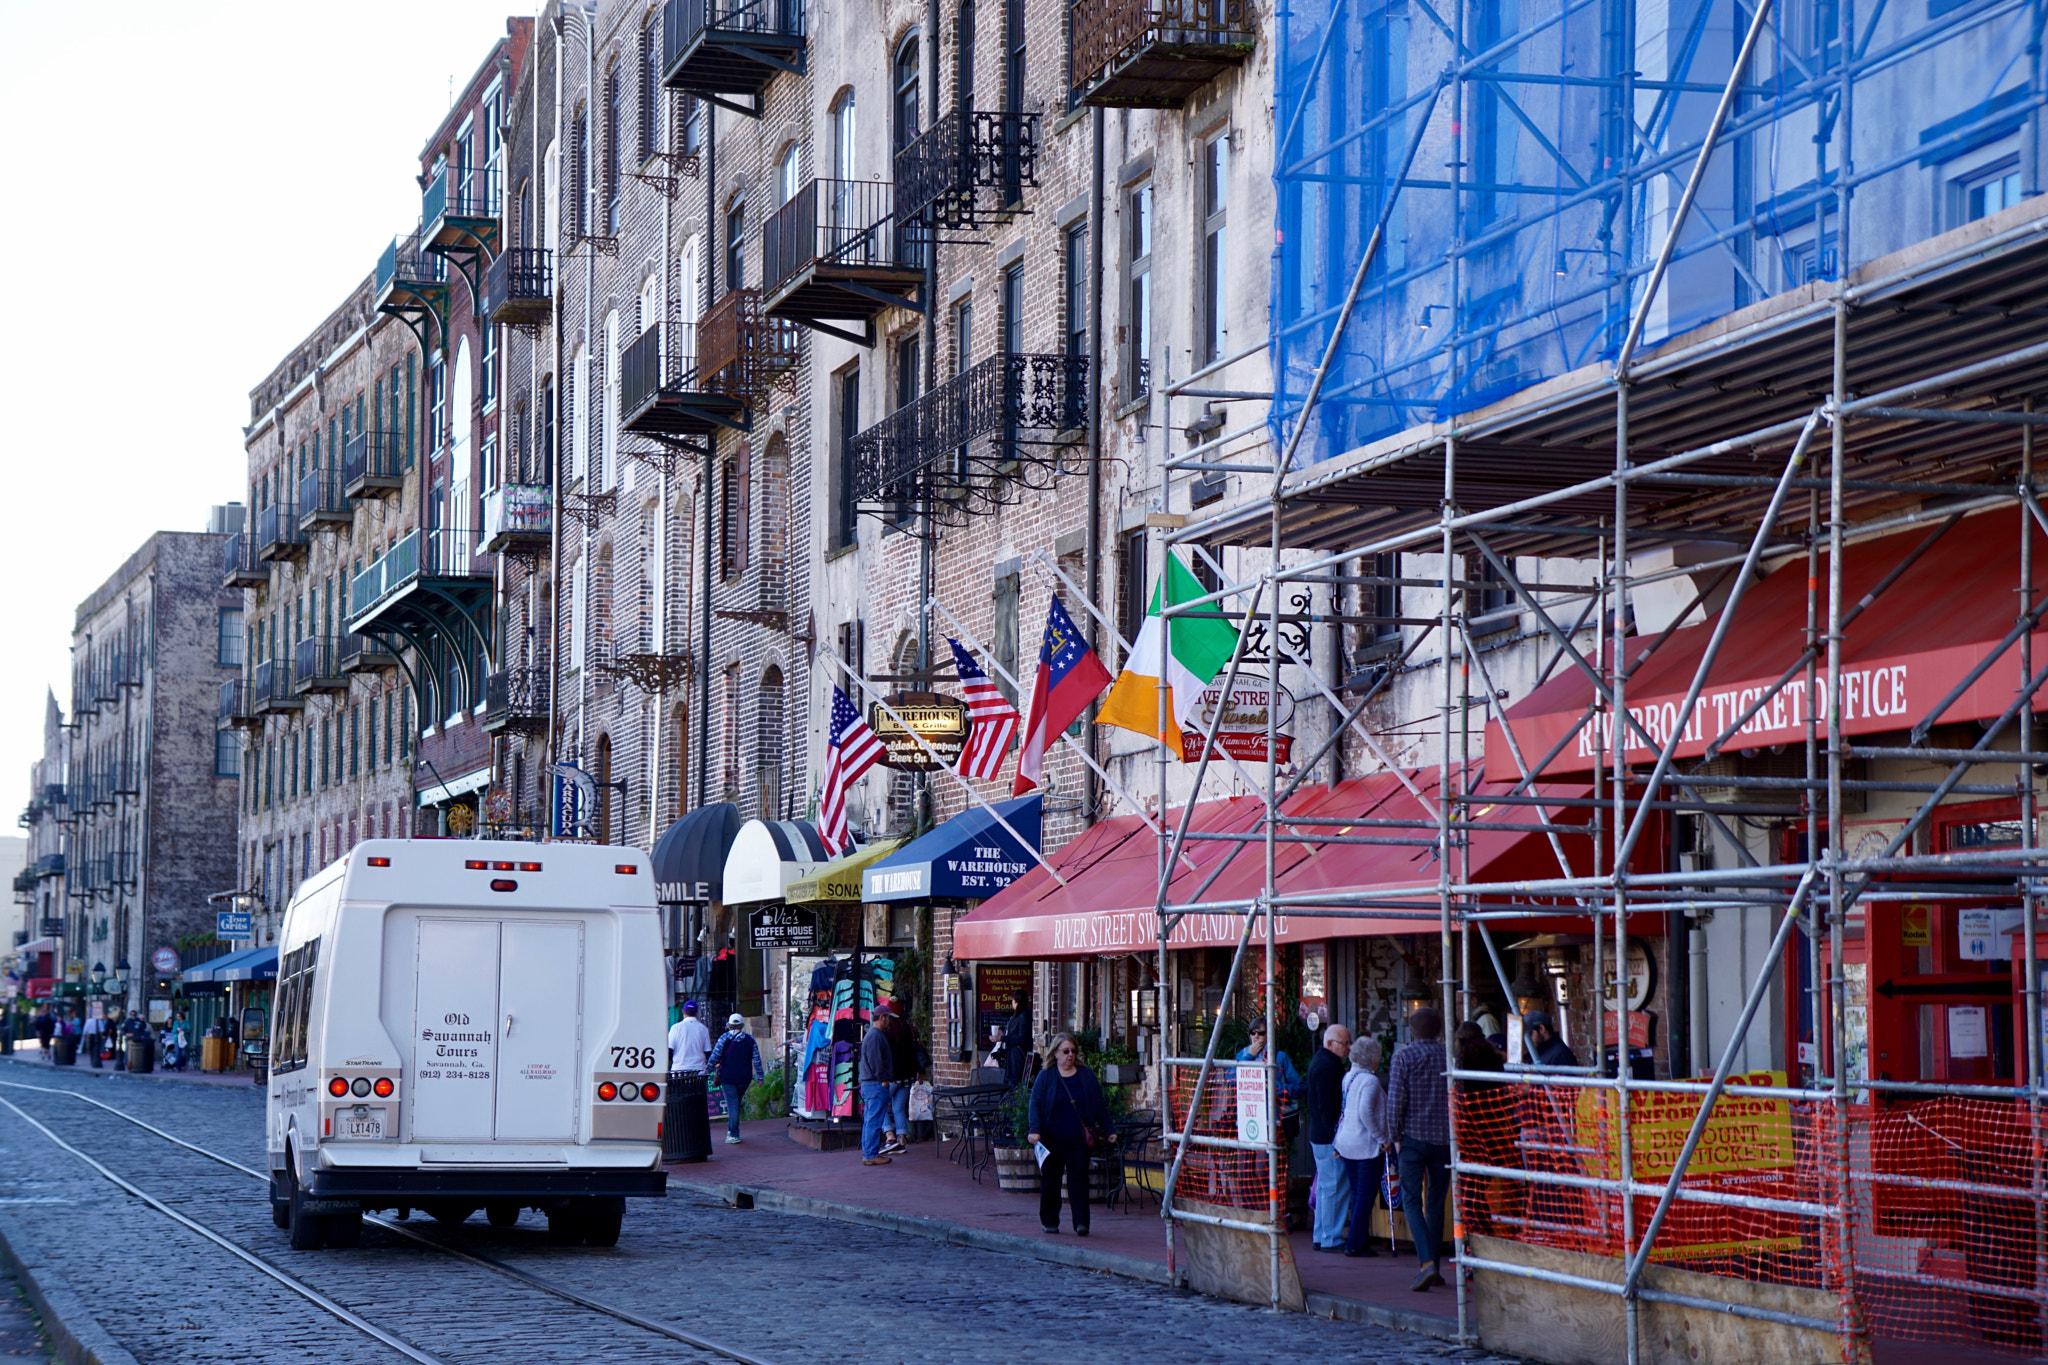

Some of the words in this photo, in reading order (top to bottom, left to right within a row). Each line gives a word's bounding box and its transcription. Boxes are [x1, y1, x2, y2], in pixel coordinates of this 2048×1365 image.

[1217, 734, 1250, 747] Famous
[888, 751, 913, 763] Beer
[561, 777, 574, 835] BARRACUDA
[973, 846, 1001, 859] THE
[947, 860, 1027, 874] WAREHOUSE
[871, 874, 883, 894] THE
[884, 870, 922, 893] WAREHOUSE
[961, 875, 990, 887] EST.
[770, 906, 800, 925] Vic's
[754, 926, 785, 937] COFFEE
[787, 925, 814, 936] HOUSE
[1053, 917, 1088, 949] RIVER
[1090, 913, 1136, 948] STREET
[1190, 913, 1238, 943] CANDY
[1903, 930, 1927, 939] Kodak
[985, 968, 1032, 976] WAREHOUSE
[981, 993, 1001, 1002] DAILY
[444, 1012, 470, 1026] Old
[422, 1028, 491, 1045] Savannah
[436, 1044, 478, 1057] Tours
[610, 1046, 655, 1069] 736
[419, 1069, 441, 1079] (912)
[445, 1070, 490, 1079] 234-8128
[1252, 1068, 1262, 1079] CLIMB
[1243, 1081, 1264, 1092] SCAFFOLDING
[1245, 1104, 1258, 1118] ONLY
